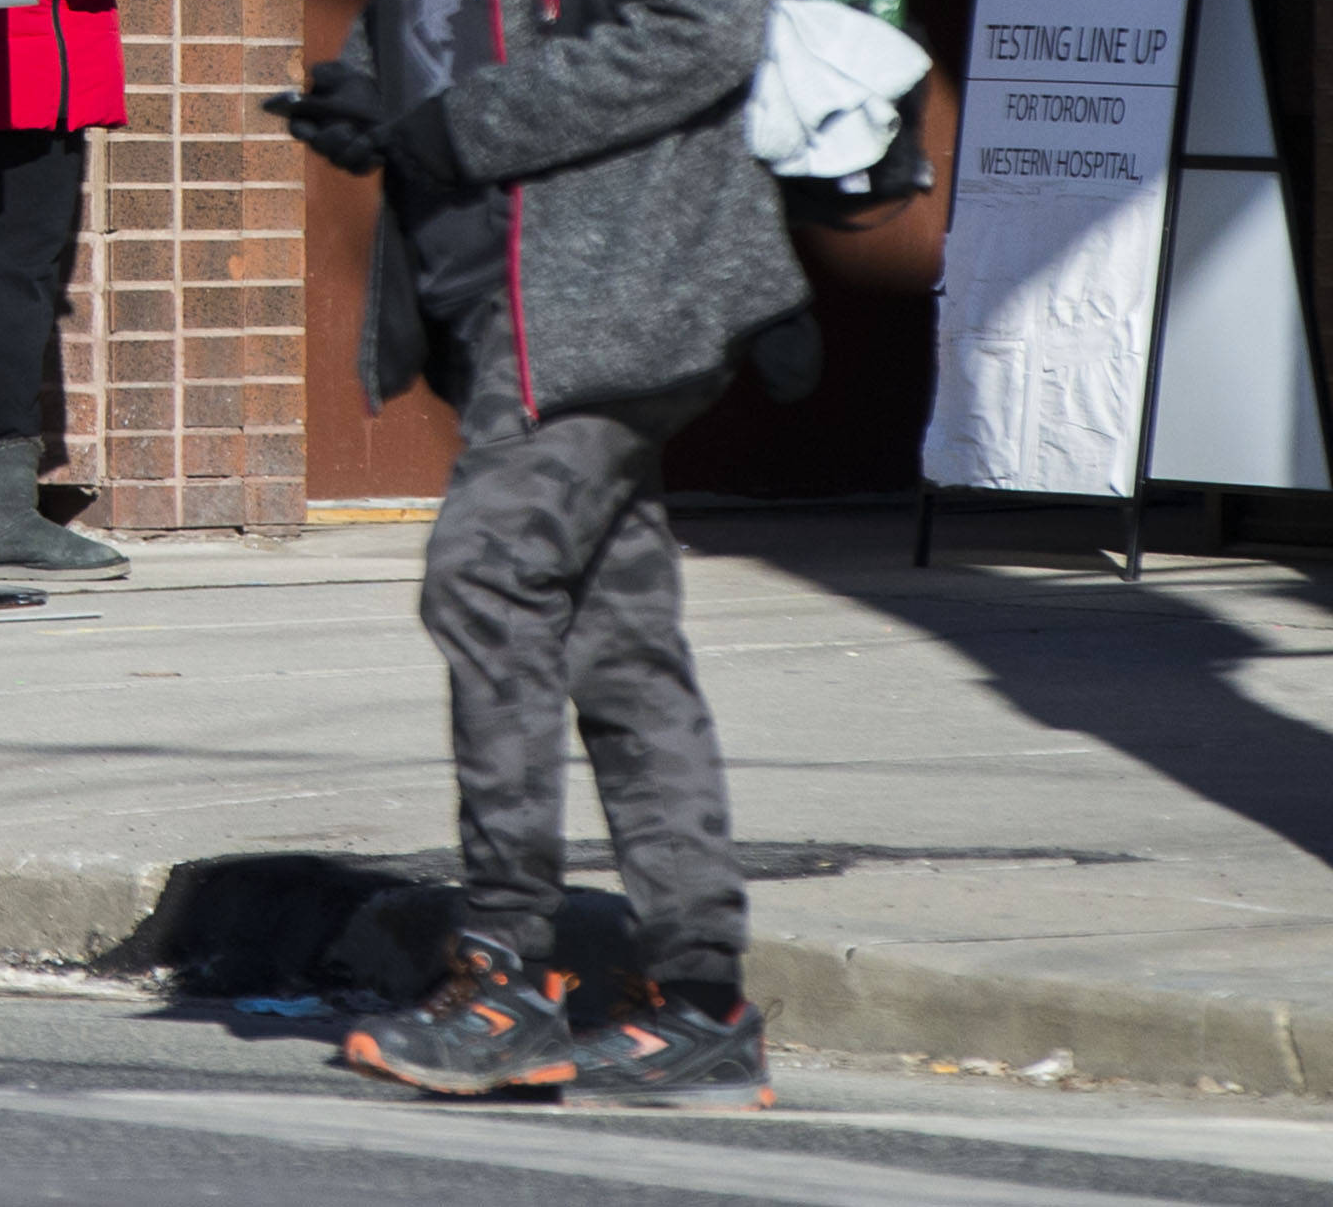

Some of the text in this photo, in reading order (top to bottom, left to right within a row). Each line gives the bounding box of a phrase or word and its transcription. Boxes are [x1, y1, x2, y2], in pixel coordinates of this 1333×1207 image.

[986, 24, 1167, 65] TESTING LINE UP
[1006, 93, 1126, 125] FOR TORONTO
[980, 146, 1053, 177] WESTERN
